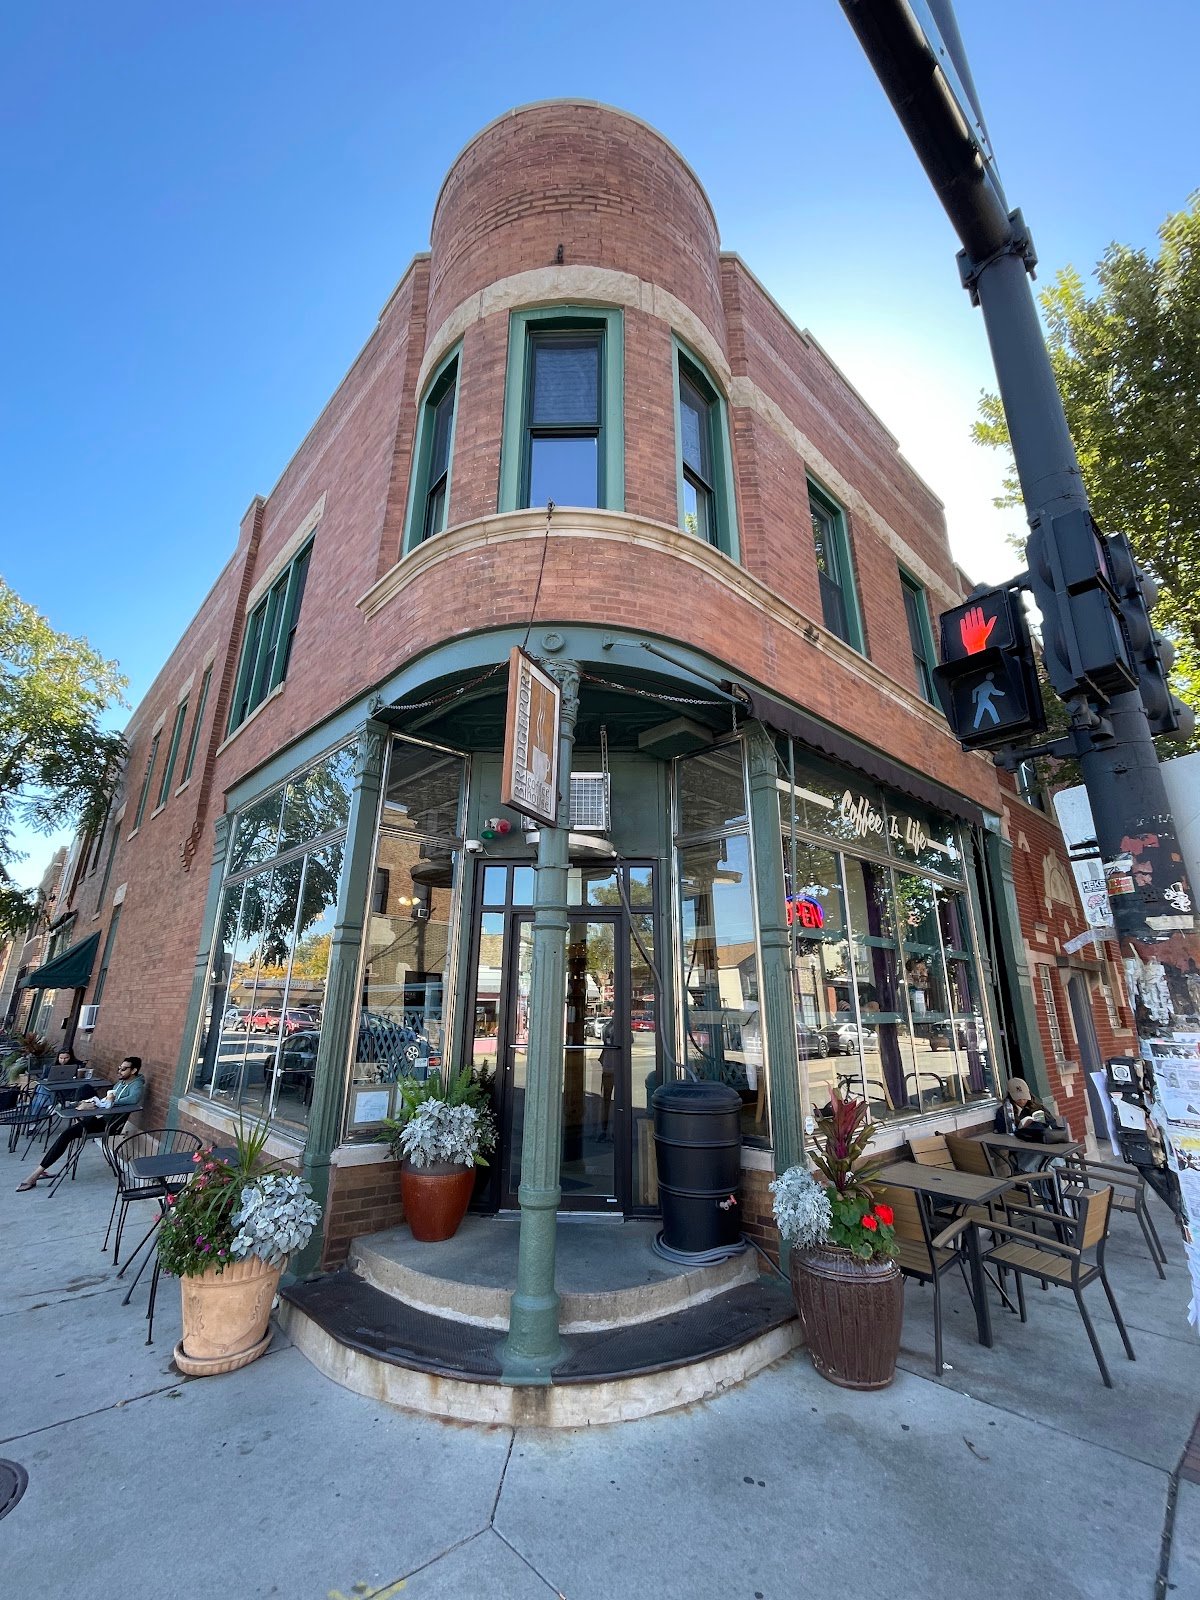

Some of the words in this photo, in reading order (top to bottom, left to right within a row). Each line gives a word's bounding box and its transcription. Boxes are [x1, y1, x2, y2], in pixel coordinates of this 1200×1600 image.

[513, 659, 531, 801] BRIDGEPORT
[525, 785, 550, 812] house
[527, 776, 550, 798] coffee
[840, 789, 884, 838] Coffee
[906, 816, 927, 856] Life
